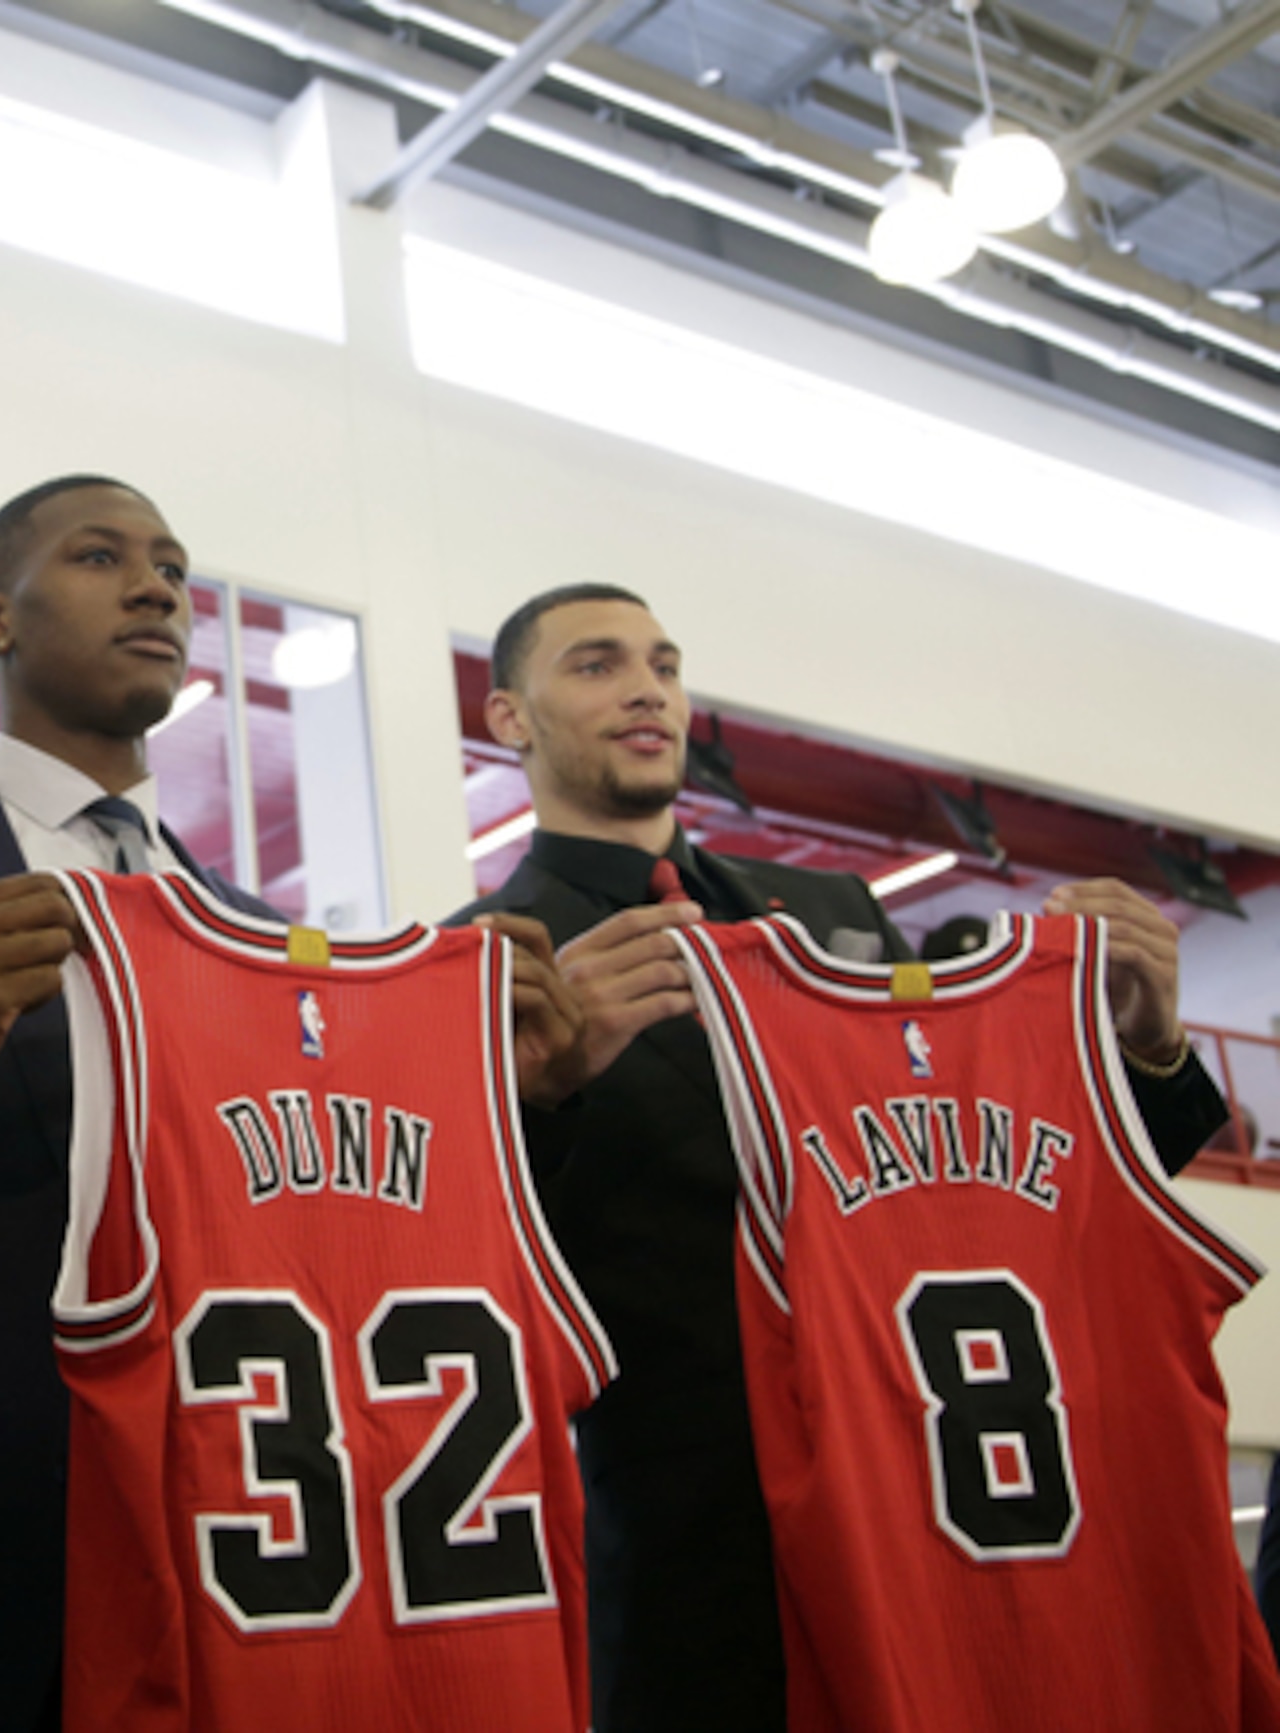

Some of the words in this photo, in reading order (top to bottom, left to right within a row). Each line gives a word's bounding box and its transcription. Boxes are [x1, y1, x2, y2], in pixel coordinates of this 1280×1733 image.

[216, 1089, 433, 1213] DUNN
[800, 1095, 1075, 1216] LAVINE
[173, 1286, 558, 1635] 32
[894, 1266, 1083, 1563] 8
